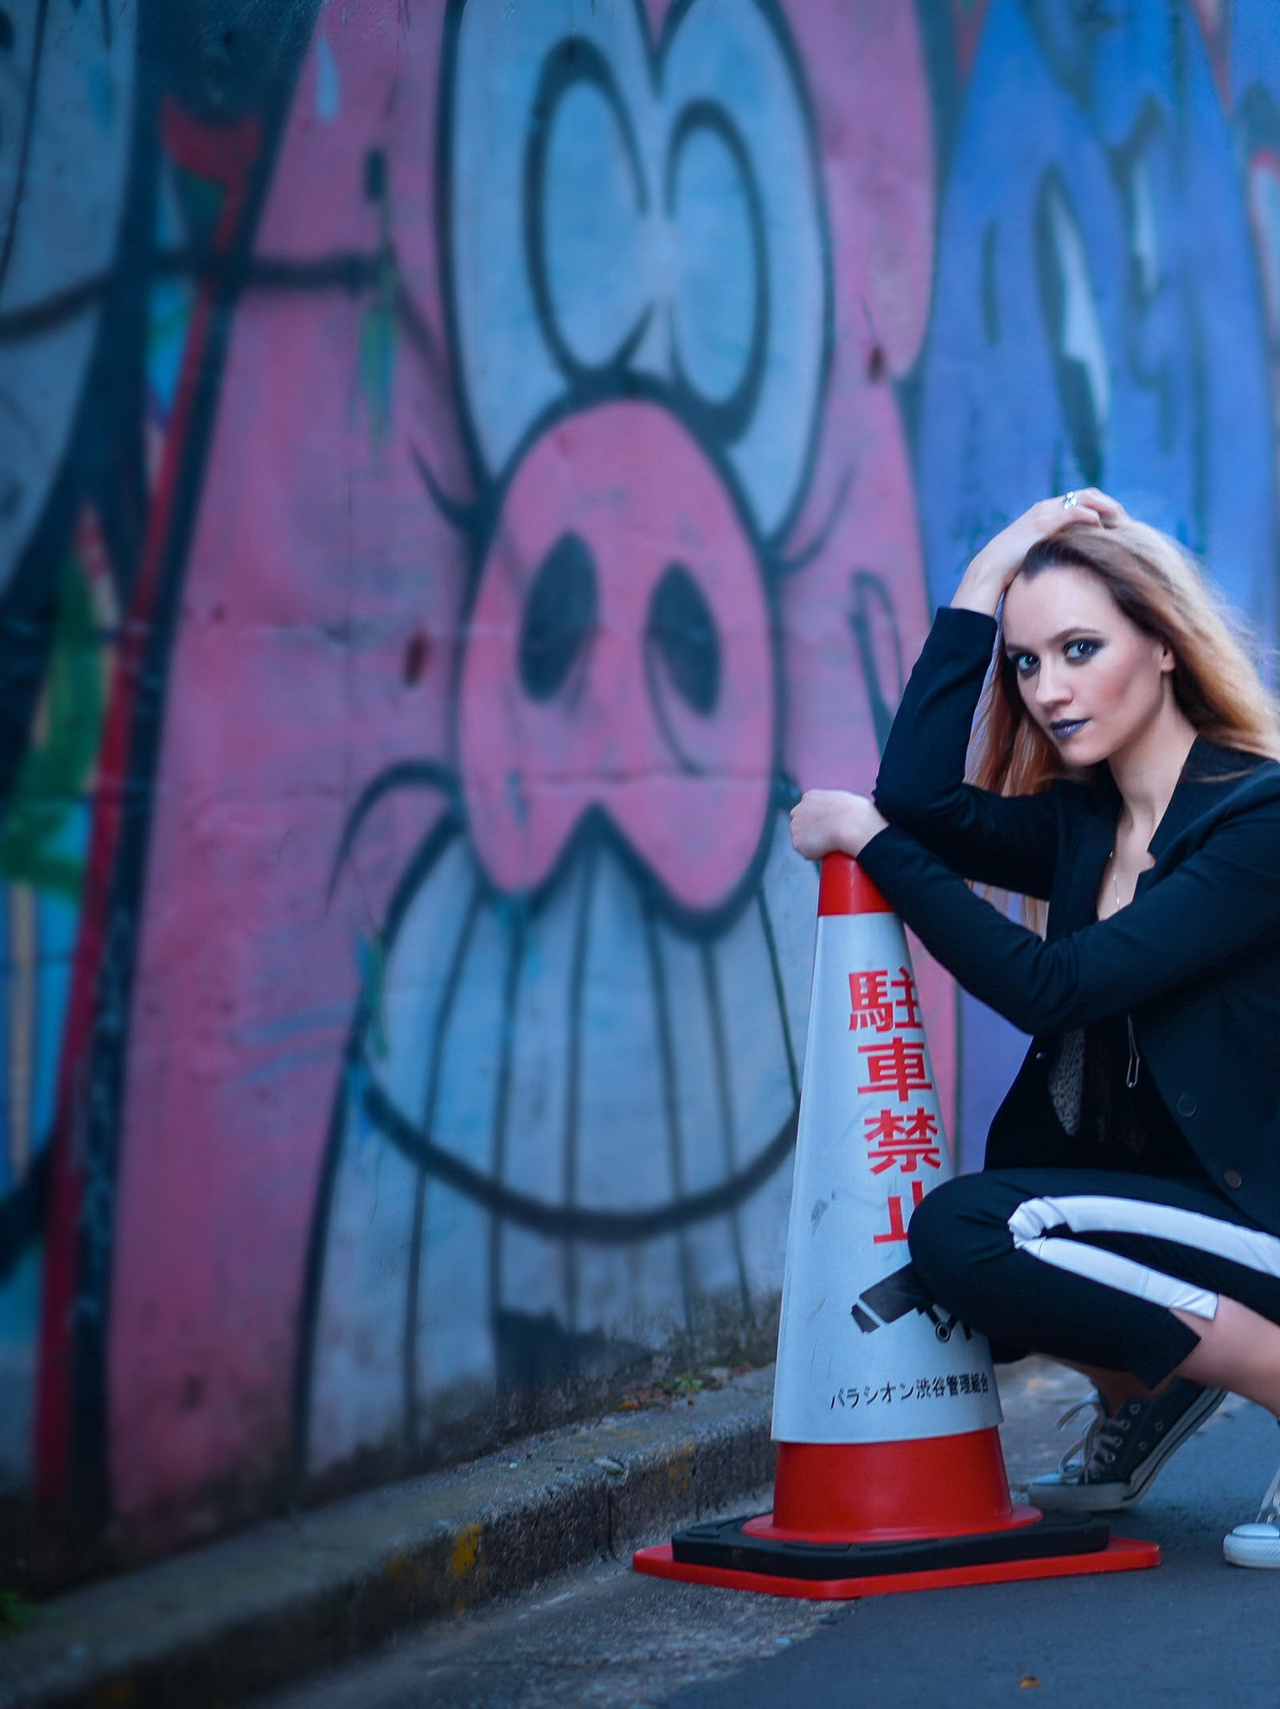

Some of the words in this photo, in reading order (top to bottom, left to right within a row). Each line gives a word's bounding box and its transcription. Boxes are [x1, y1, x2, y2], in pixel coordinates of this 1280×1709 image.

[829, 1372, 989, 1410] パラシオン渋谷管理組合
